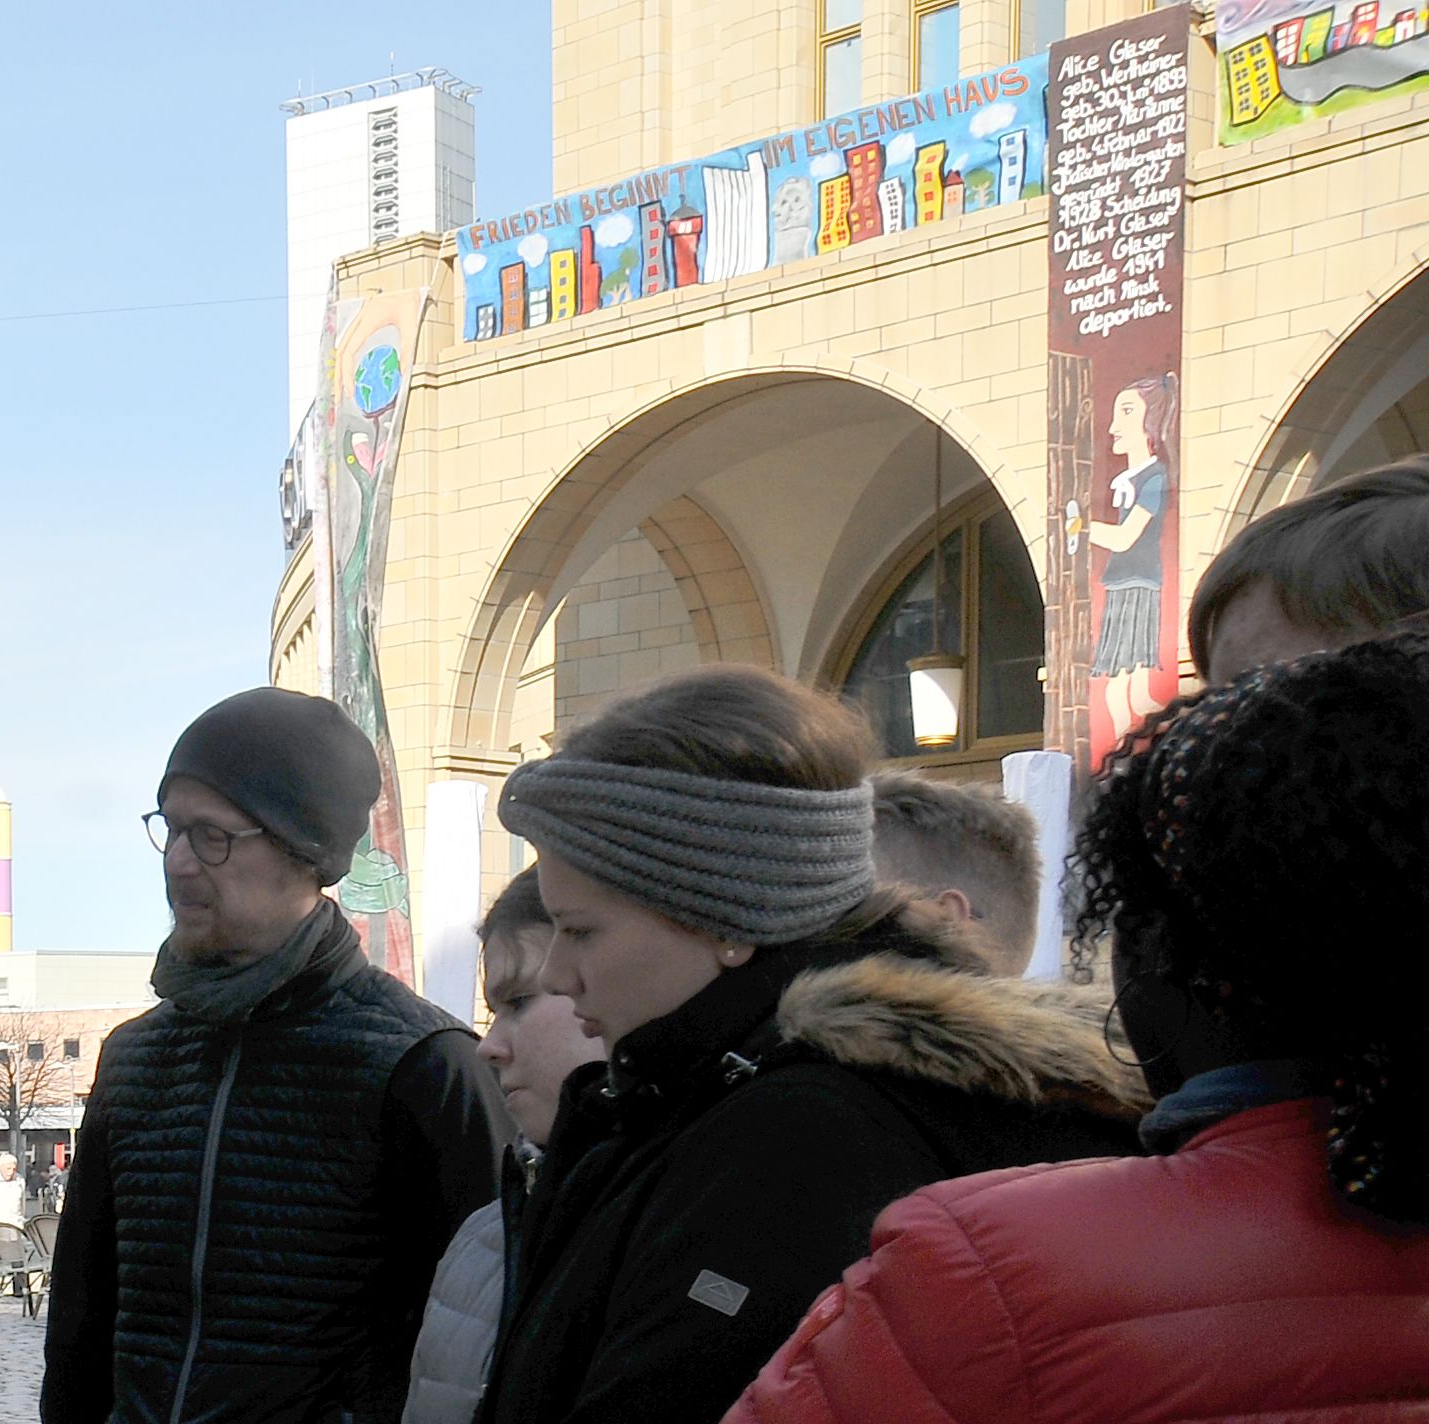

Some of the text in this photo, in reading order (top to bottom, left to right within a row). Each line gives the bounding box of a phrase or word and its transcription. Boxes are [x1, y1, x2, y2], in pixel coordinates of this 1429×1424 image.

[1058, 35, 1166, 81] Alice Glaser
[1061, 75, 1100, 107] geb.
[1056, 115, 1119, 144] Tochter
[469, 68, 1030, 249] FRIEDEN BEGINNT IM EIGENEN HAUS
[1104, 187, 1181, 217] Scheidung
[1053, 206, 1178, 253] Dr. Kurt Glaser
[1112, 232, 1174, 260] Glaser
[1064, 264, 1118, 295] wurde
[1070, 286, 1116, 315] nach
[1079, 294, 1173, 338] deportiert.
